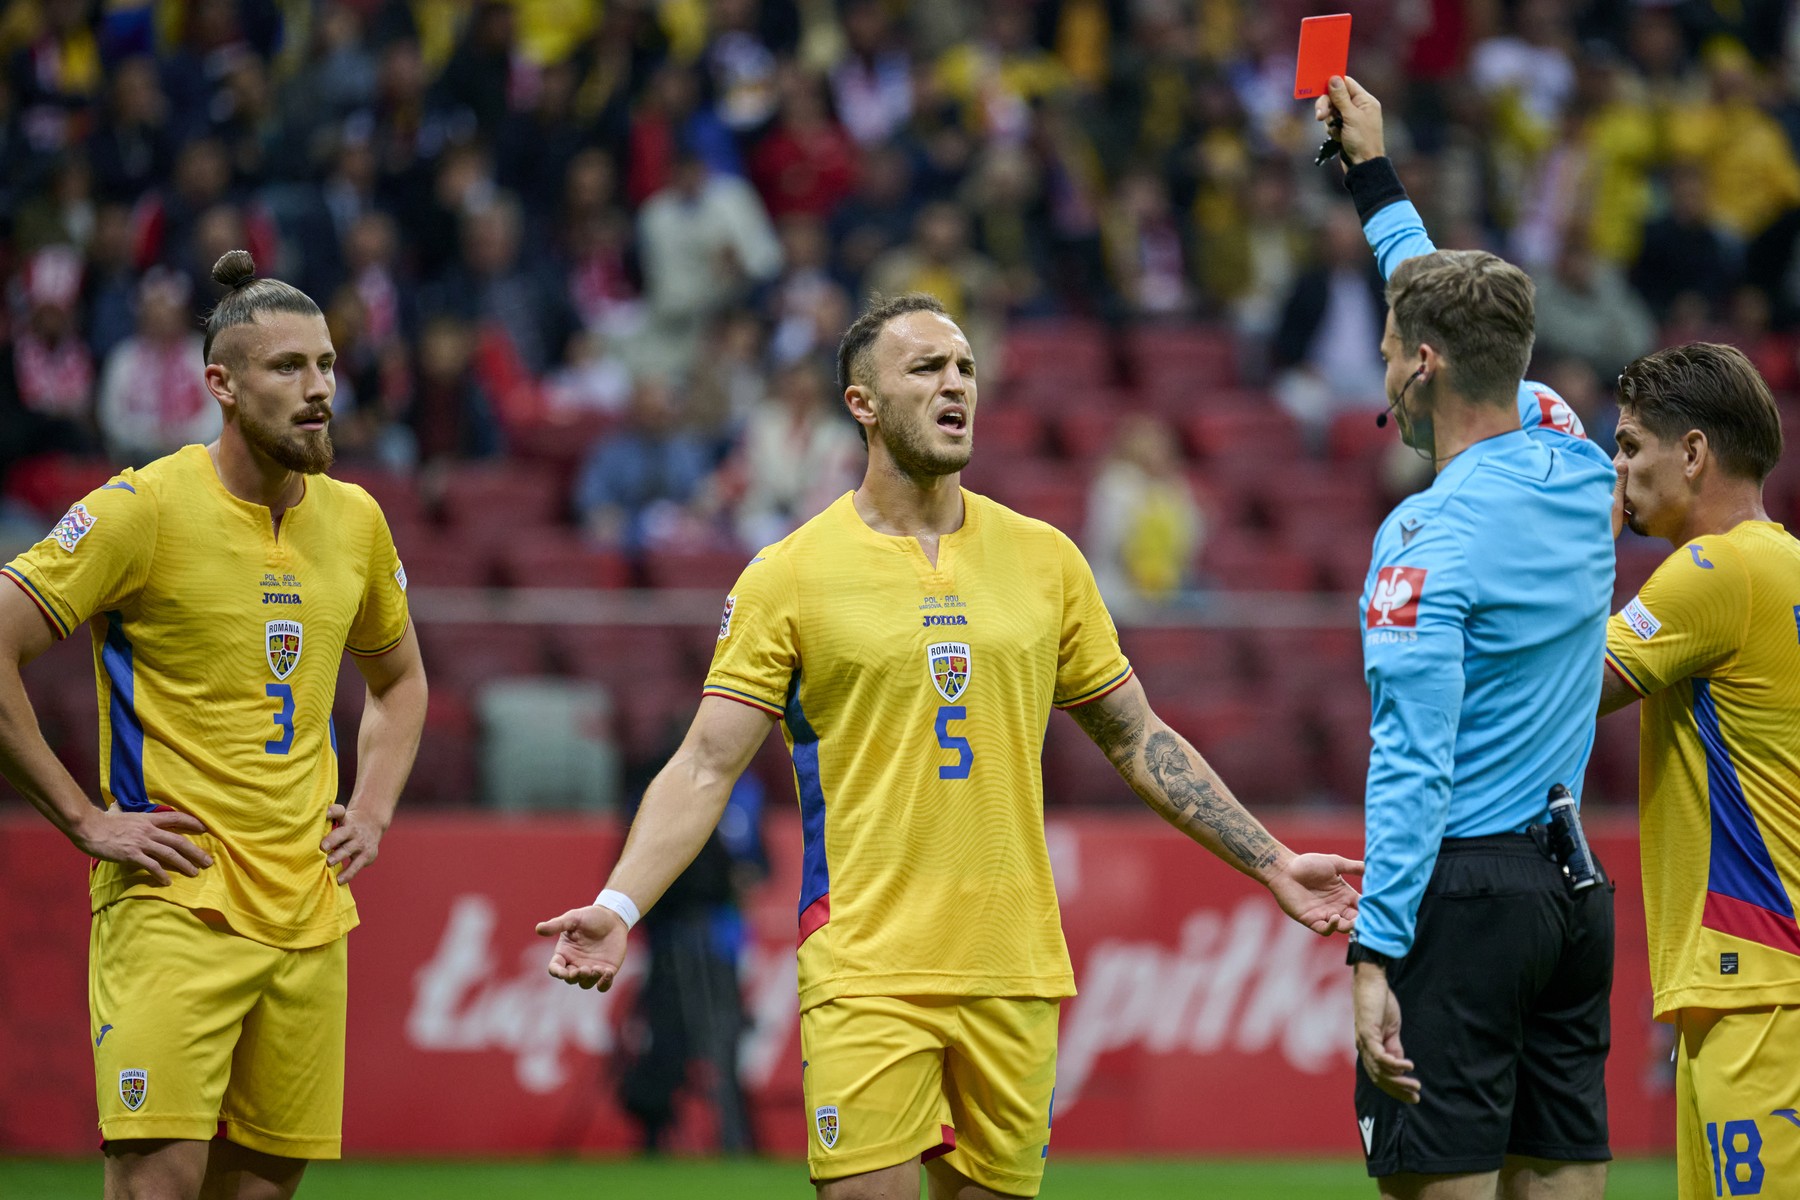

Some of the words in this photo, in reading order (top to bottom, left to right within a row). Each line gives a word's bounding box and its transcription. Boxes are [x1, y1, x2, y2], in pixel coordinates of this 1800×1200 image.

[268, 621, 300, 634] ROMÂNIA
[931, 643, 967, 656] ROMÂNIA
[265, 683, 295, 755] 3
[934, 706, 974, 779] 5
[121, 1070, 145, 1079] ROMÂNIA
[1706, 1119, 1765, 1197] 18
